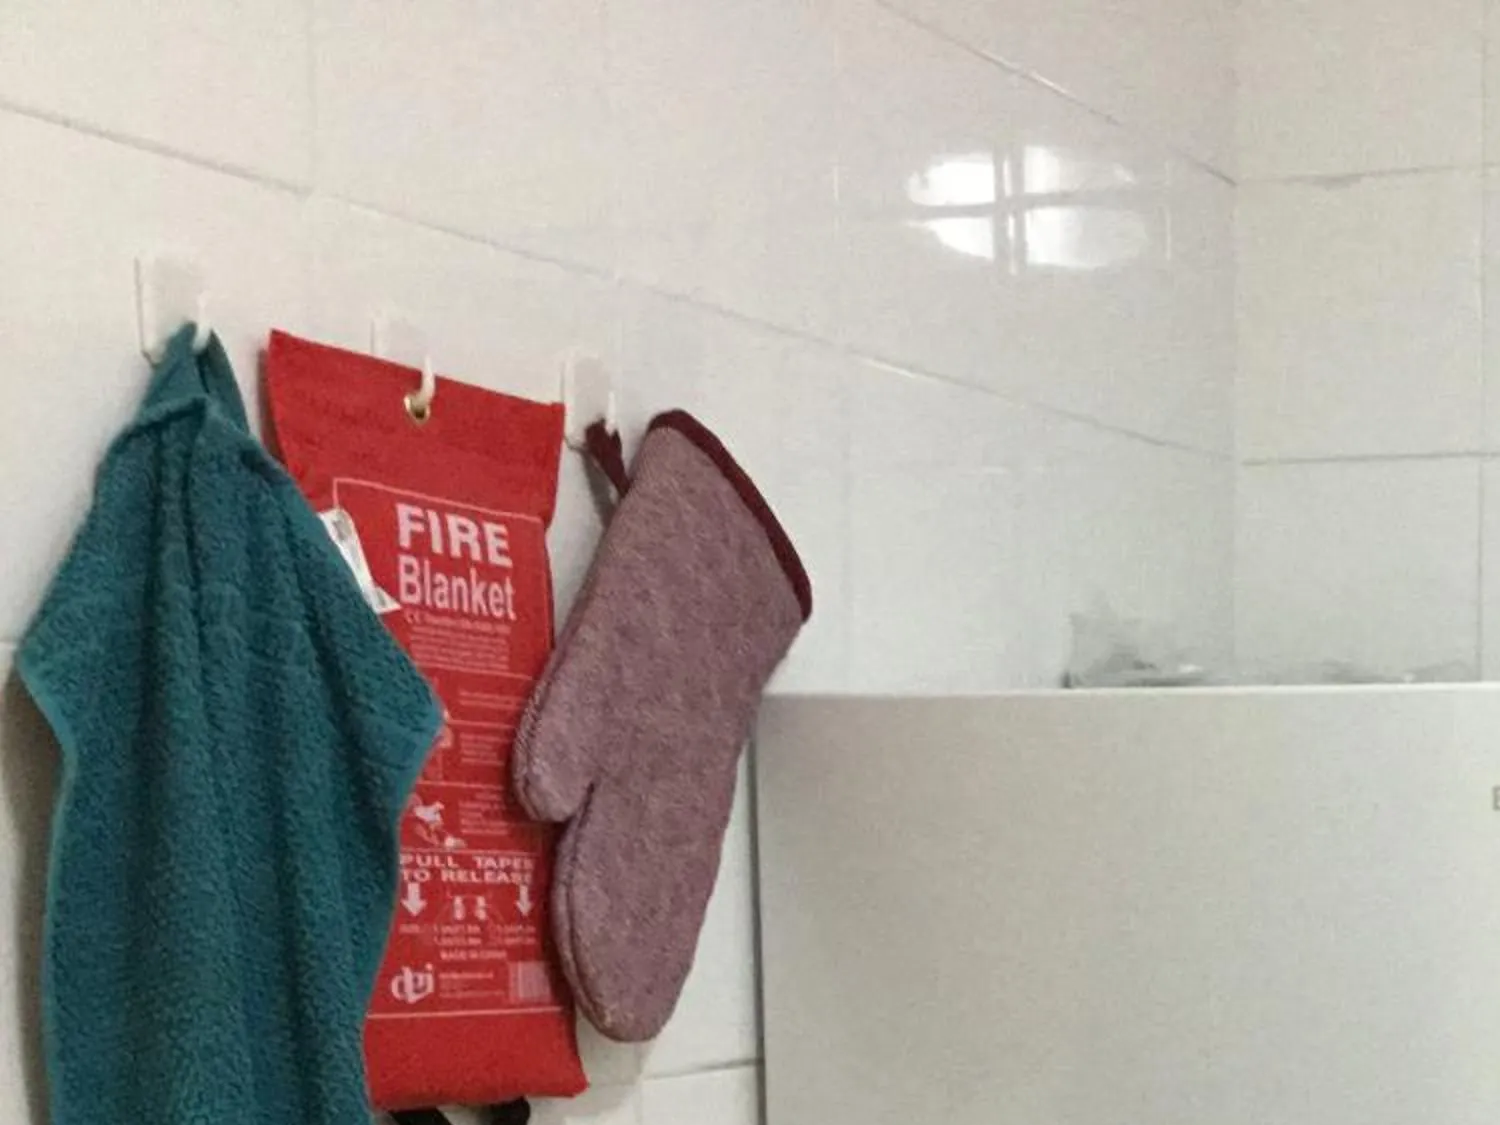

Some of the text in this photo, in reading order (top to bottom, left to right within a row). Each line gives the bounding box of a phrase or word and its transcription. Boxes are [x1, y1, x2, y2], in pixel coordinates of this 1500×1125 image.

[396, 502, 513, 569] FIRE
[398, 553, 517, 621] Blanket
[399, 852, 459, 868] PULL
[400, 868, 533, 885] TO RELEASE
